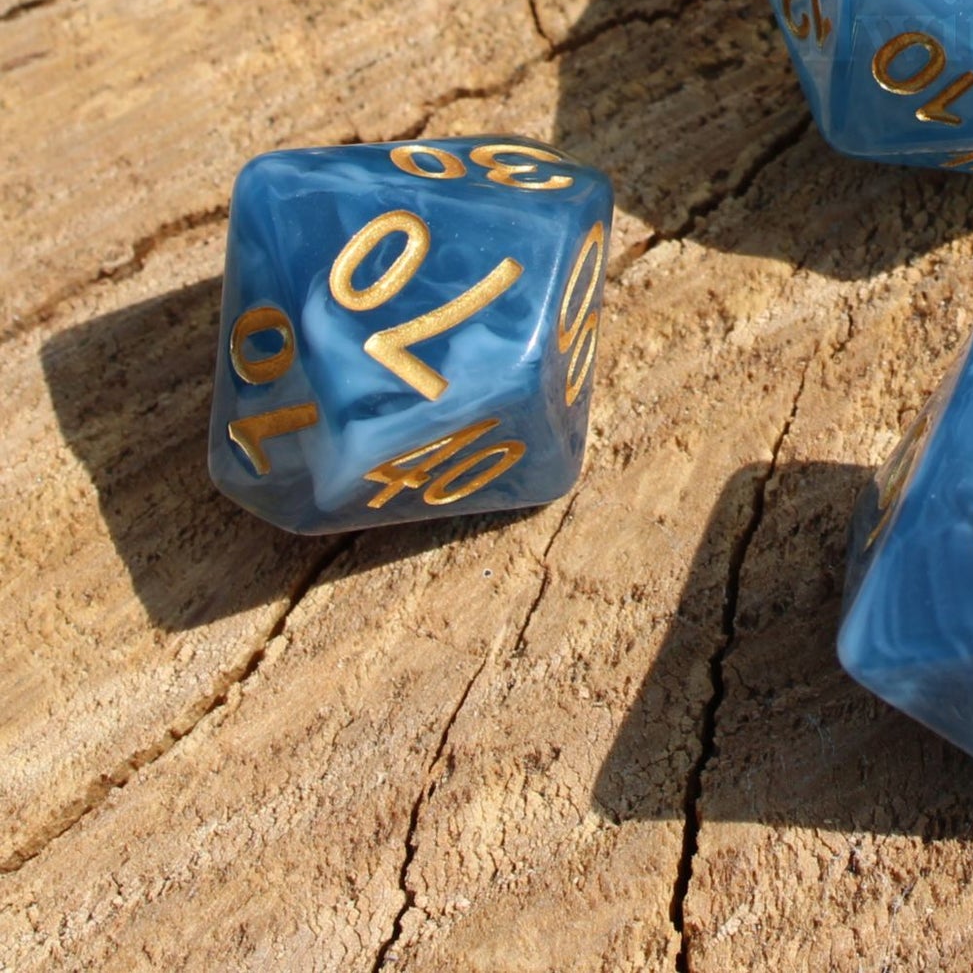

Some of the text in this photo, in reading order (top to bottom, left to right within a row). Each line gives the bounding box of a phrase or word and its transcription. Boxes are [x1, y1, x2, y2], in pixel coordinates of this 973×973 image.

[389, 144, 575, 191] 30
[329, 209, 524, 402] 70
[228, 307, 320, 476] 10
[363, 418, 528, 509] 40
